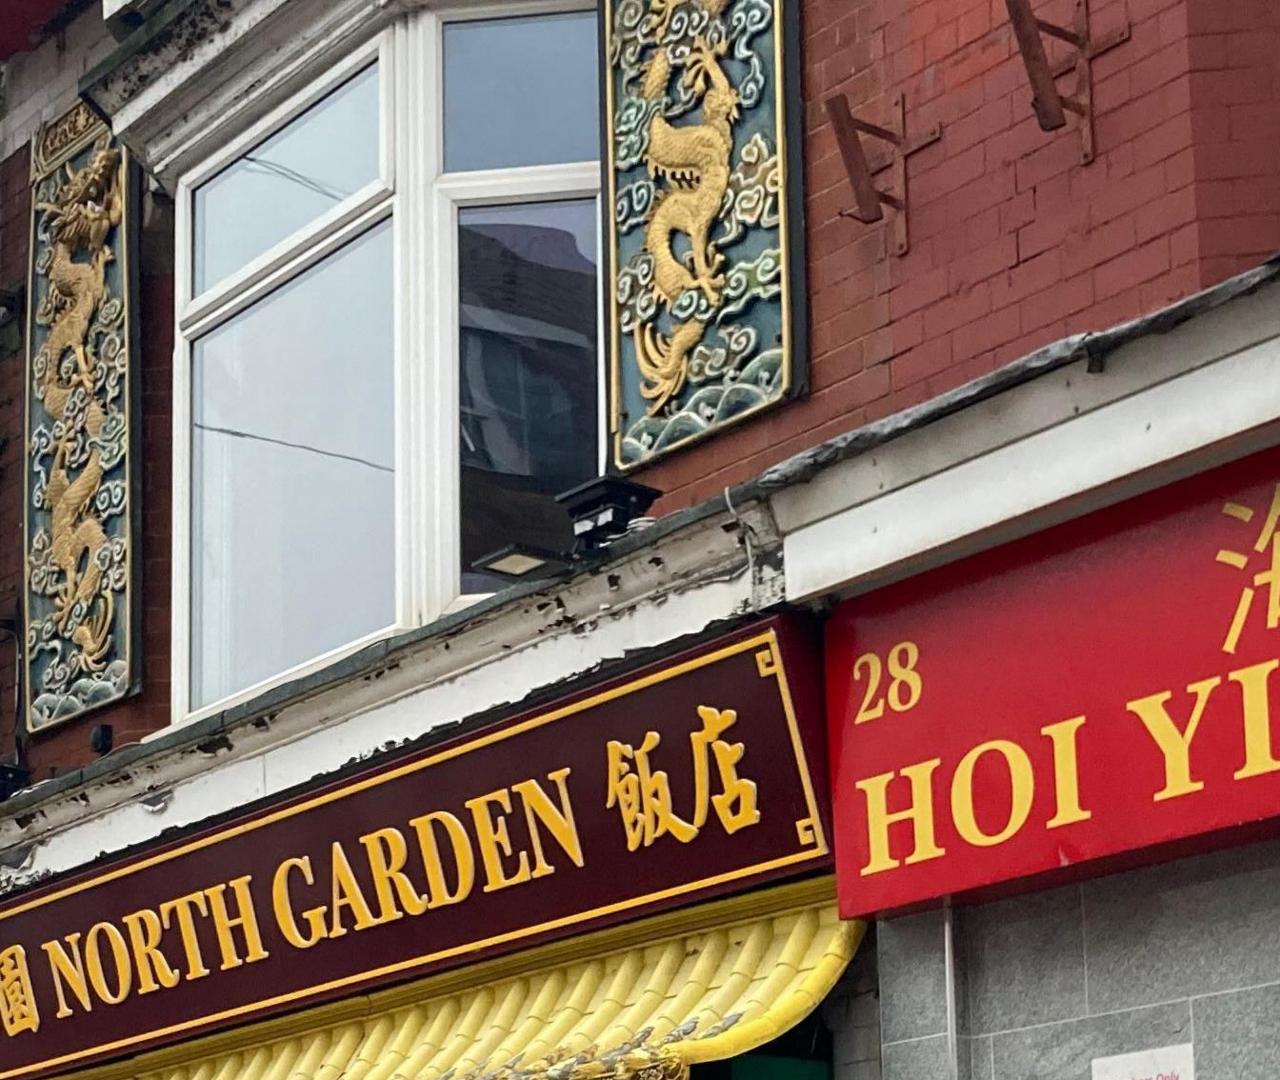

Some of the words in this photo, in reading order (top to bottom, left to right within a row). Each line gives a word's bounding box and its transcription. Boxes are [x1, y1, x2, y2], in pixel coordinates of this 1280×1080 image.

[852, 641, 923, 724] 28
[41, 873, 270, 1019] NORTH
[272, 766, 587, 949] GARDEN
[606, 704, 761, 852] 飯店
[854, 714, 1092, 878] HOI
